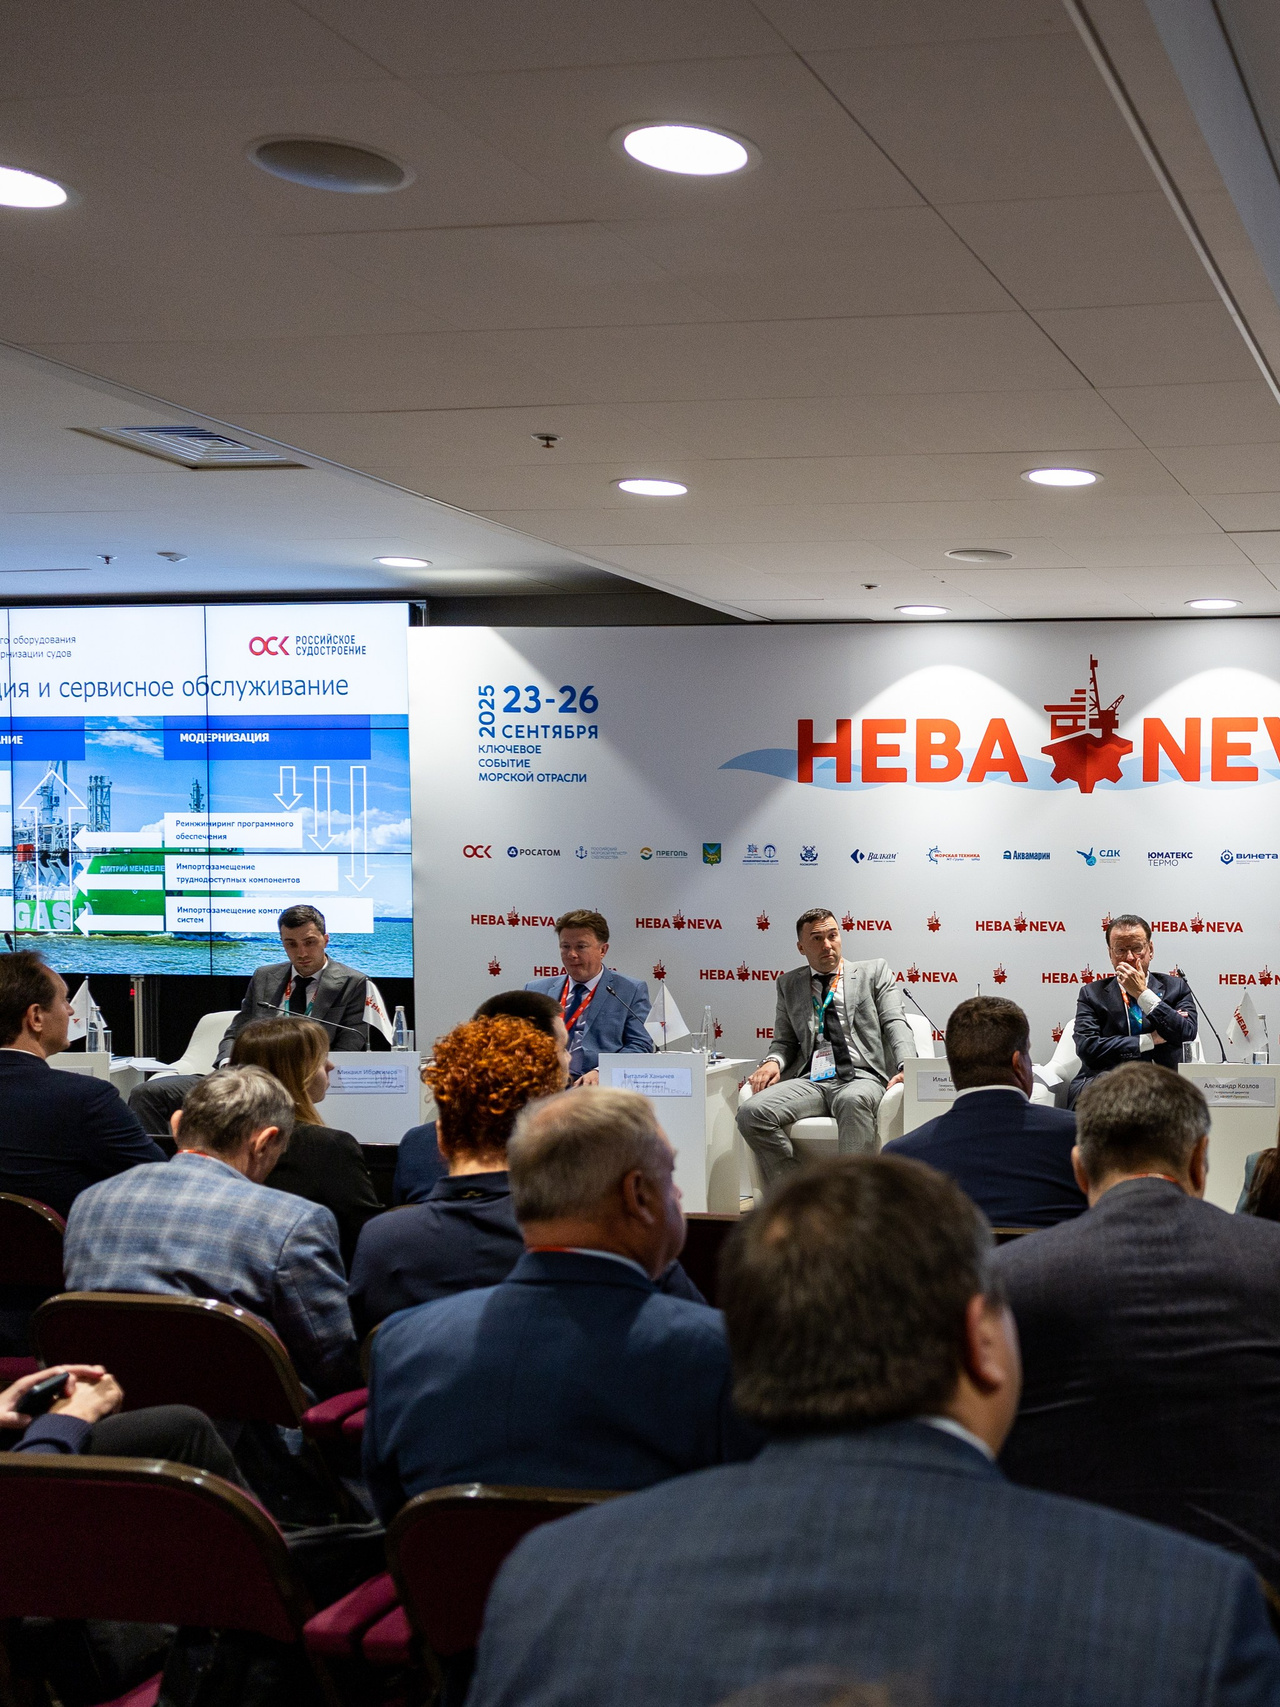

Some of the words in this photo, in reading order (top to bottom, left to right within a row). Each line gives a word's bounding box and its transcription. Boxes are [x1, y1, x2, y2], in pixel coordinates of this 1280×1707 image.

[13, 635, 77, 647] оборудования
[295, 633, 356, 645] РОССИЙСКОЕ
[248, 635, 290, 656] ОСК
[295, 645, 367, 656] СУДОСТРОЕНИЕ
[0, 650, 44, 660] рнизации
[46, 649, 72, 660] судов
[38, 681, 51, 698] и
[59, 680, 174, 703] сервисное
[182, 675, 349, 702] обслуживание
[502, 685, 599, 714] 23-26
[478, 684, 496, 739] 2025
[501, 724, 599, 739] СЕНТЯБРЯ
[179, 732, 270, 744] МОДЕРНИЗАЦИЯ
[478, 744, 542, 754] КЛЮЧЕВОЕ
[797, 717, 1030, 785] НЕВА
[478, 758, 531, 768] СОБЫТИЕ
[478, 770, 534, 782] МОРСКОЙ
[536, 773, 587, 783] ОТРАСЛИ
[175, 819, 235, 830] Реинжиниринг
[237, 820, 294, 831] программного
[175, 832, 227, 841] обеспечения
[462, 844, 493, 859] ОСК
[519, 848, 561, 857] РОСАТОМ
[1013, 850, 1051, 861] Аквамарин
[1099, 849, 1121, 858] СДК
[1147, 851, 1193, 859] ЮМАТЕКС
[129, 865, 165, 873] МЕНДЕЛЕ
[176, 862, 256, 873] Импортозамещение
[1147, 859, 1179, 867] ТЕРМО
[176, 876, 247, 886] труднодоступных
[248, 876, 301, 884] компонентов
[177, 906, 257, 916] Импортозамещение
[177, 916, 204, 924] систем
[471, 914, 506, 926] НЕВА
[521, 916, 556, 927] NEVA
[635, 917, 671, 929] НЕВА
[687, 918, 723, 930] NEVA
[856, 920, 893, 931] NEVA
[975, 920, 1013, 932] НЕВА
[1029, 920, 1066, 932] NEVA
[1151, 921, 1189, 933] НЕВА
[1206, 921, 1244, 933] NEVA
[533, 965, 568, 977] НЕВА
[699, 969, 735, 981] НЕВА
[922, 971, 959, 983] NEVA
[1041, 972, 1079, 984] НЕВА
[1218, 973, 1257, 985] НЕВА
[1204, 1082, 1237, 1090] Александр
